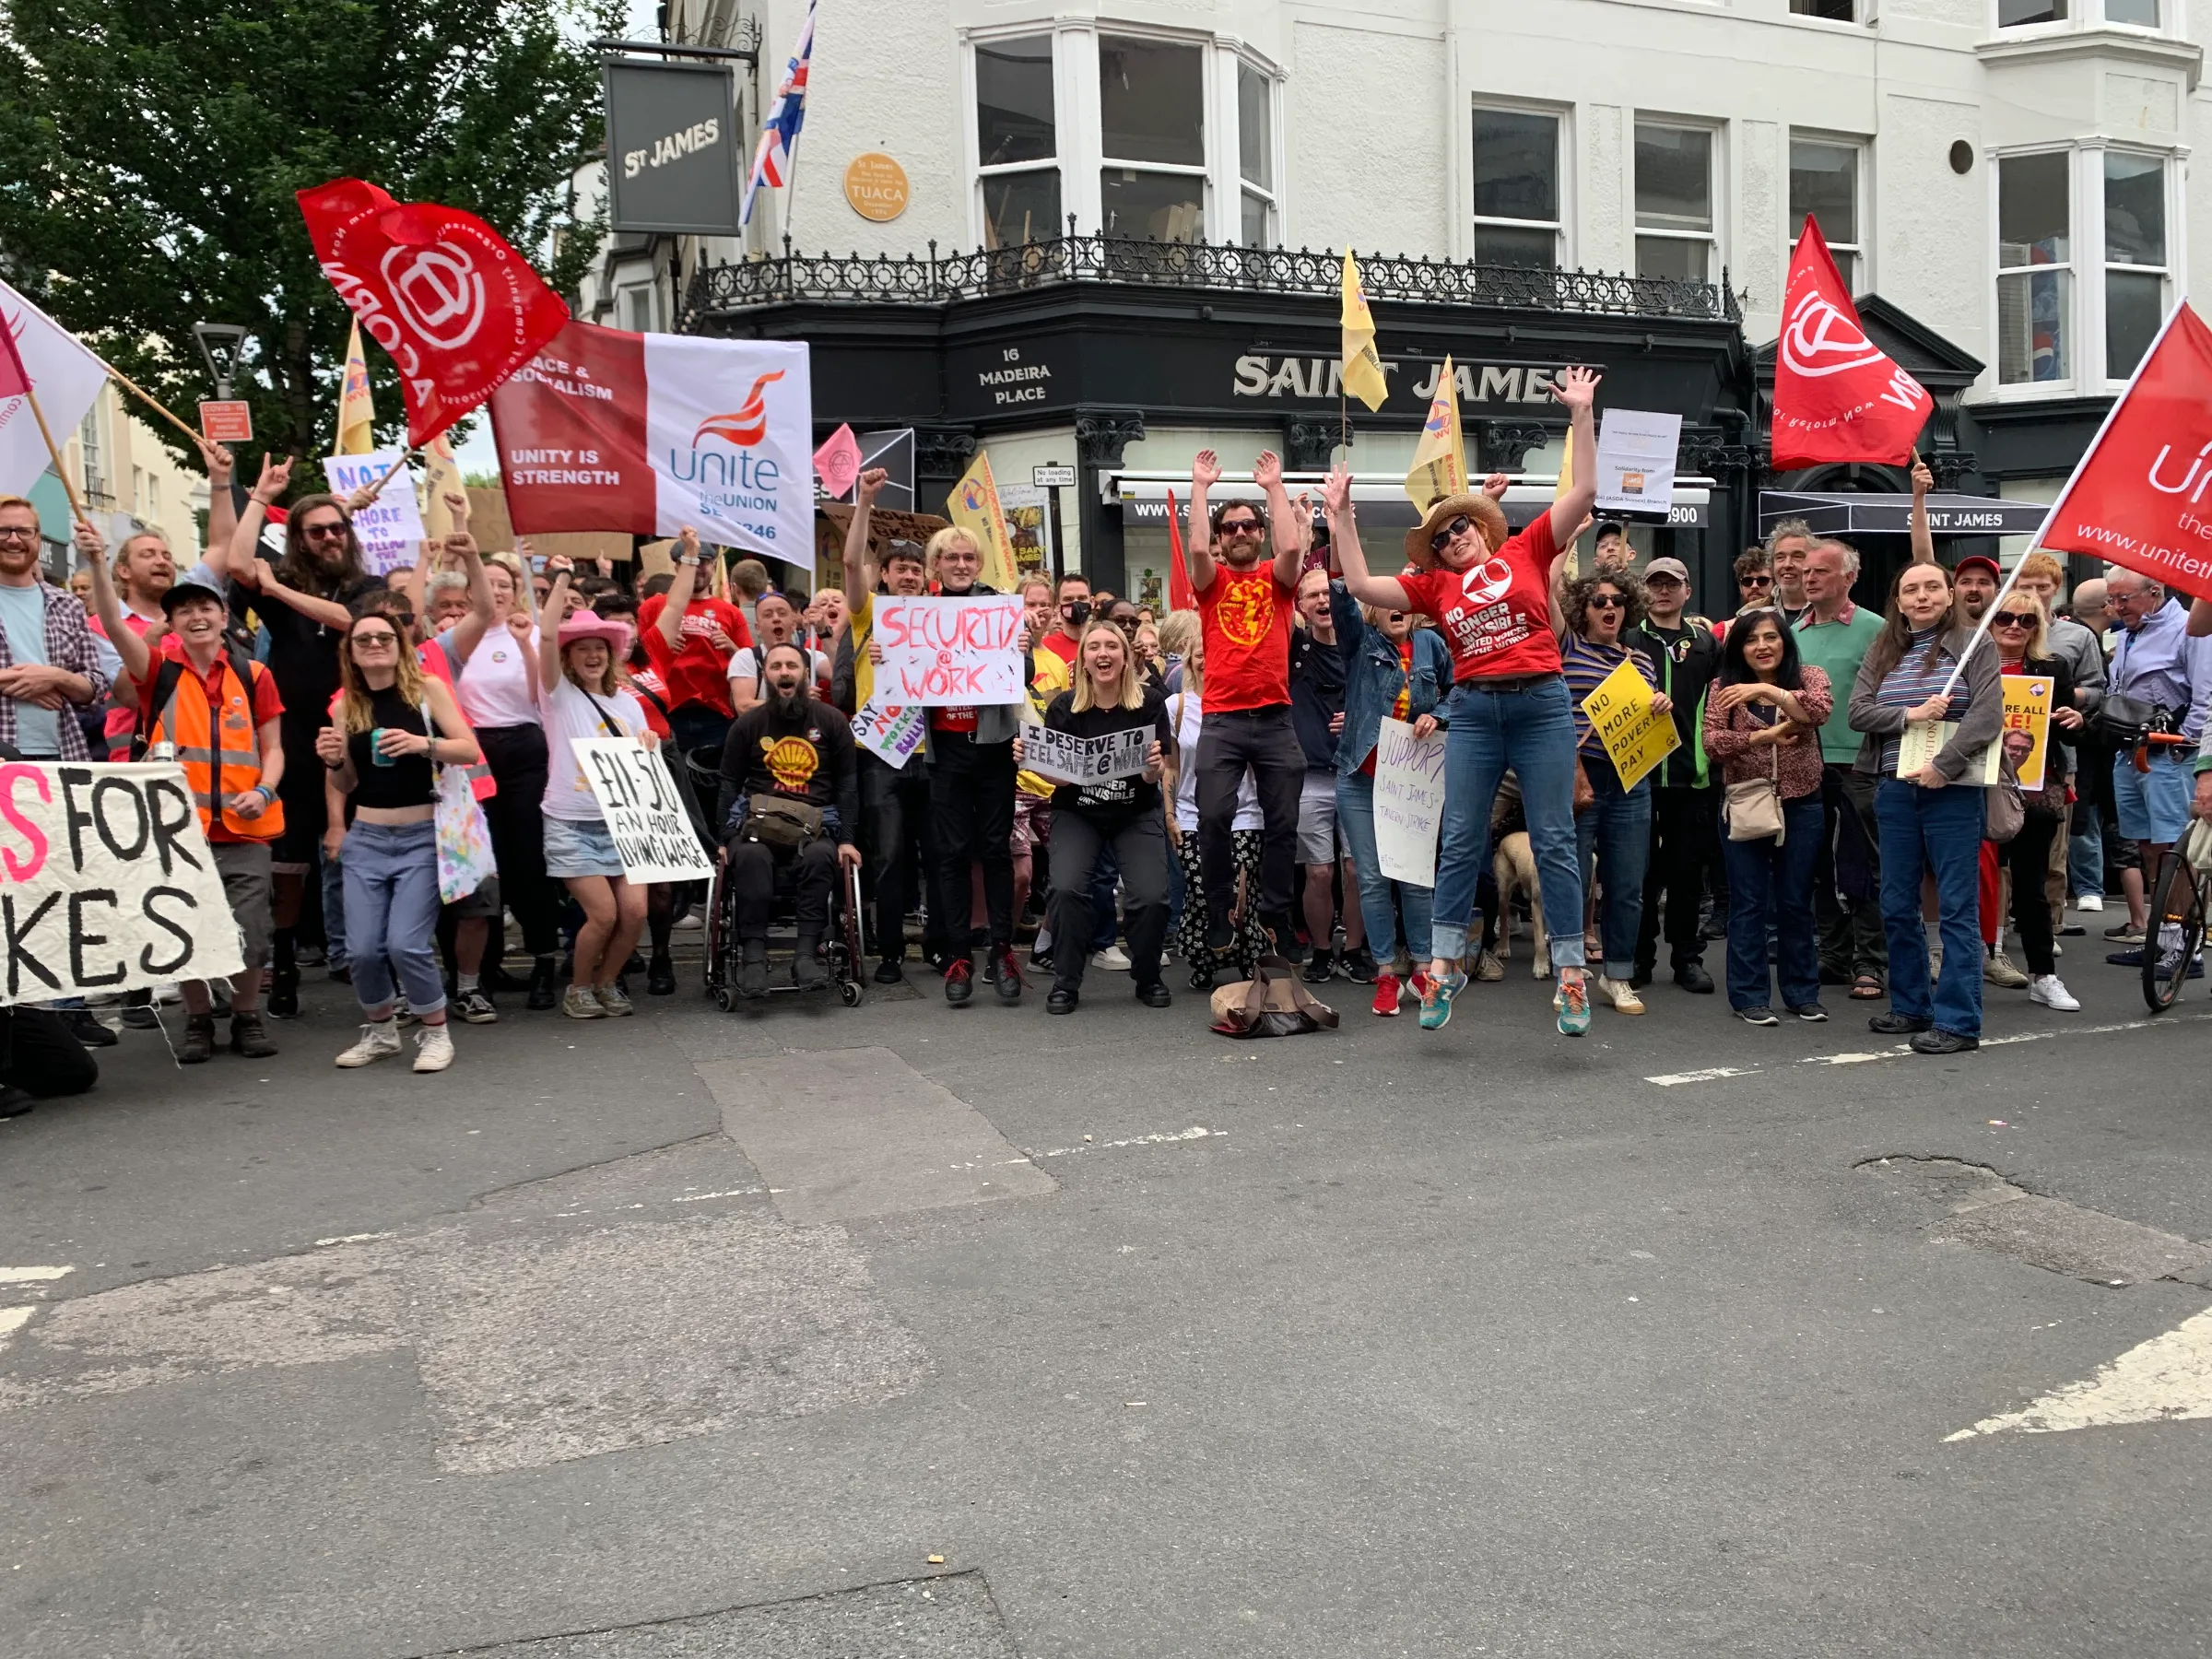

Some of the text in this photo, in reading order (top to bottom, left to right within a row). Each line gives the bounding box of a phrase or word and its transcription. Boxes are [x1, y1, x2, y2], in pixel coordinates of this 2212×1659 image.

[650, 117, 720, 168] JAMES
[852, 184, 904, 202] TUACA
[531, 355, 570, 376] ACE
[1003, 348, 1020, 361] 16
[978, 364, 1052, 386] MADEIRA
[994, 386, 1046, 405] PLACE
[512, 449, 599, 465] UNITY IS
[335, 463, 392, 491] NOT
[512, 469, 620, 485] STRENGTH
[670, 448, 780, 492] unite
[1048, 468, 1071, 477] loading
[1615, 465, 1641, 474] Solidarity
[1906, 512, 2004, 527] SINT JAMES
[368, 526, 389, 540] TO
[359, 540, 406, 553] OLLOW
[1013, 553, 1041, 562] AMES
[1002, 548, 1015, 581] WORLD
[1230, 583, 1265, 602] SJT
[1445, 606, 1465, 626] NO
[1451, 602, 1511, 638] LONGER
[881, 606, 1025, 652] SECURITY
[1460, 612, 1527, 646] INVISIBLE
[1463, 626, 1528, 653] UNITED VOICES
[936, 649, 953, 668] @
[900, 663, 988, 701] WORK
[1590, 693, 1610, 716] NO
[2005, 704, 2046, 715] RE ALL
[850, 702, 878, 736] SAY
[873, 705, 903, 736] NO
[1603, 698, 1641, 737] MORE
[1028, 724, 1145, 756] I DESERVE TO
[1612, 711, 1657, 757] POVERT
[1923, 723, 1937, 767] IGHTON
[1024, 740, 1152, 779] FEEL SAFE @ WORK
[1620, 746, 1646, 775] PAY
[1081, 786, 1135, 801] INVISIBLE
[1096, 779, 1126, 791] NGER
[1379, 774, 1404, 801] SAINT
[0, 764, 204, 883] S FOR
[616, 810, 644, 833] AN
[646, 813, 685, 836] HOUR
[616, 833, 709, 868] LIVING WAGE
